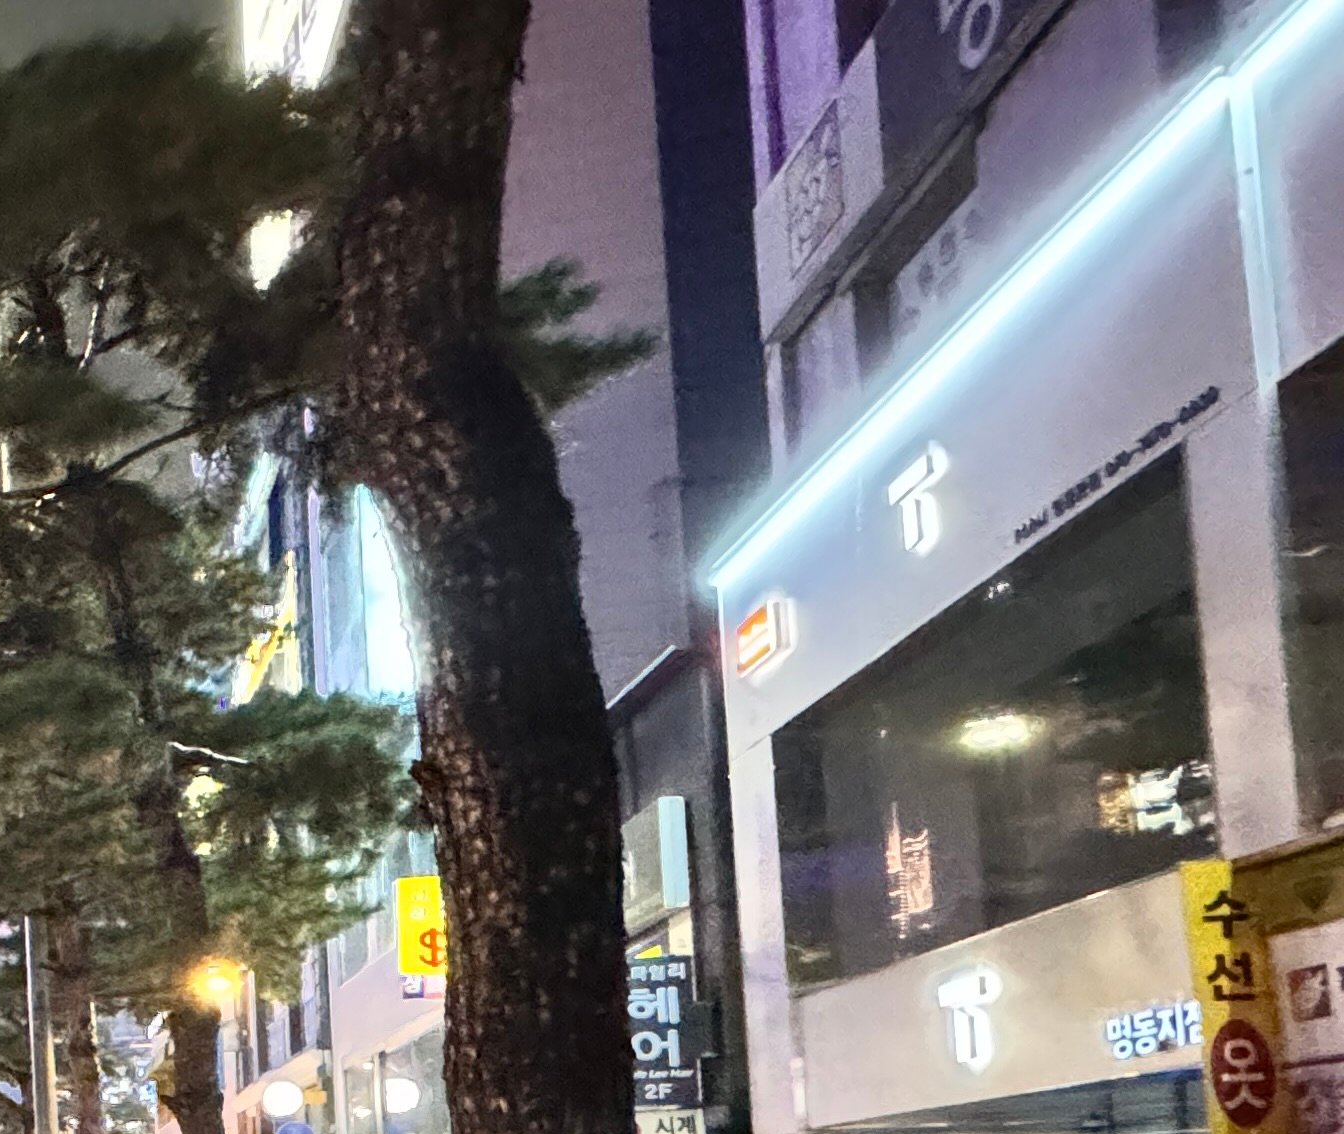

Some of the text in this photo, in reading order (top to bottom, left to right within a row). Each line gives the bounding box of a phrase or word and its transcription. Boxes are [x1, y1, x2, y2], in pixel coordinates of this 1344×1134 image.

[1202, 890, 1255, 1001] 수선
[627, 986, 681, 1068] 헤어
[644, 1083, 673, 1100] 2F
